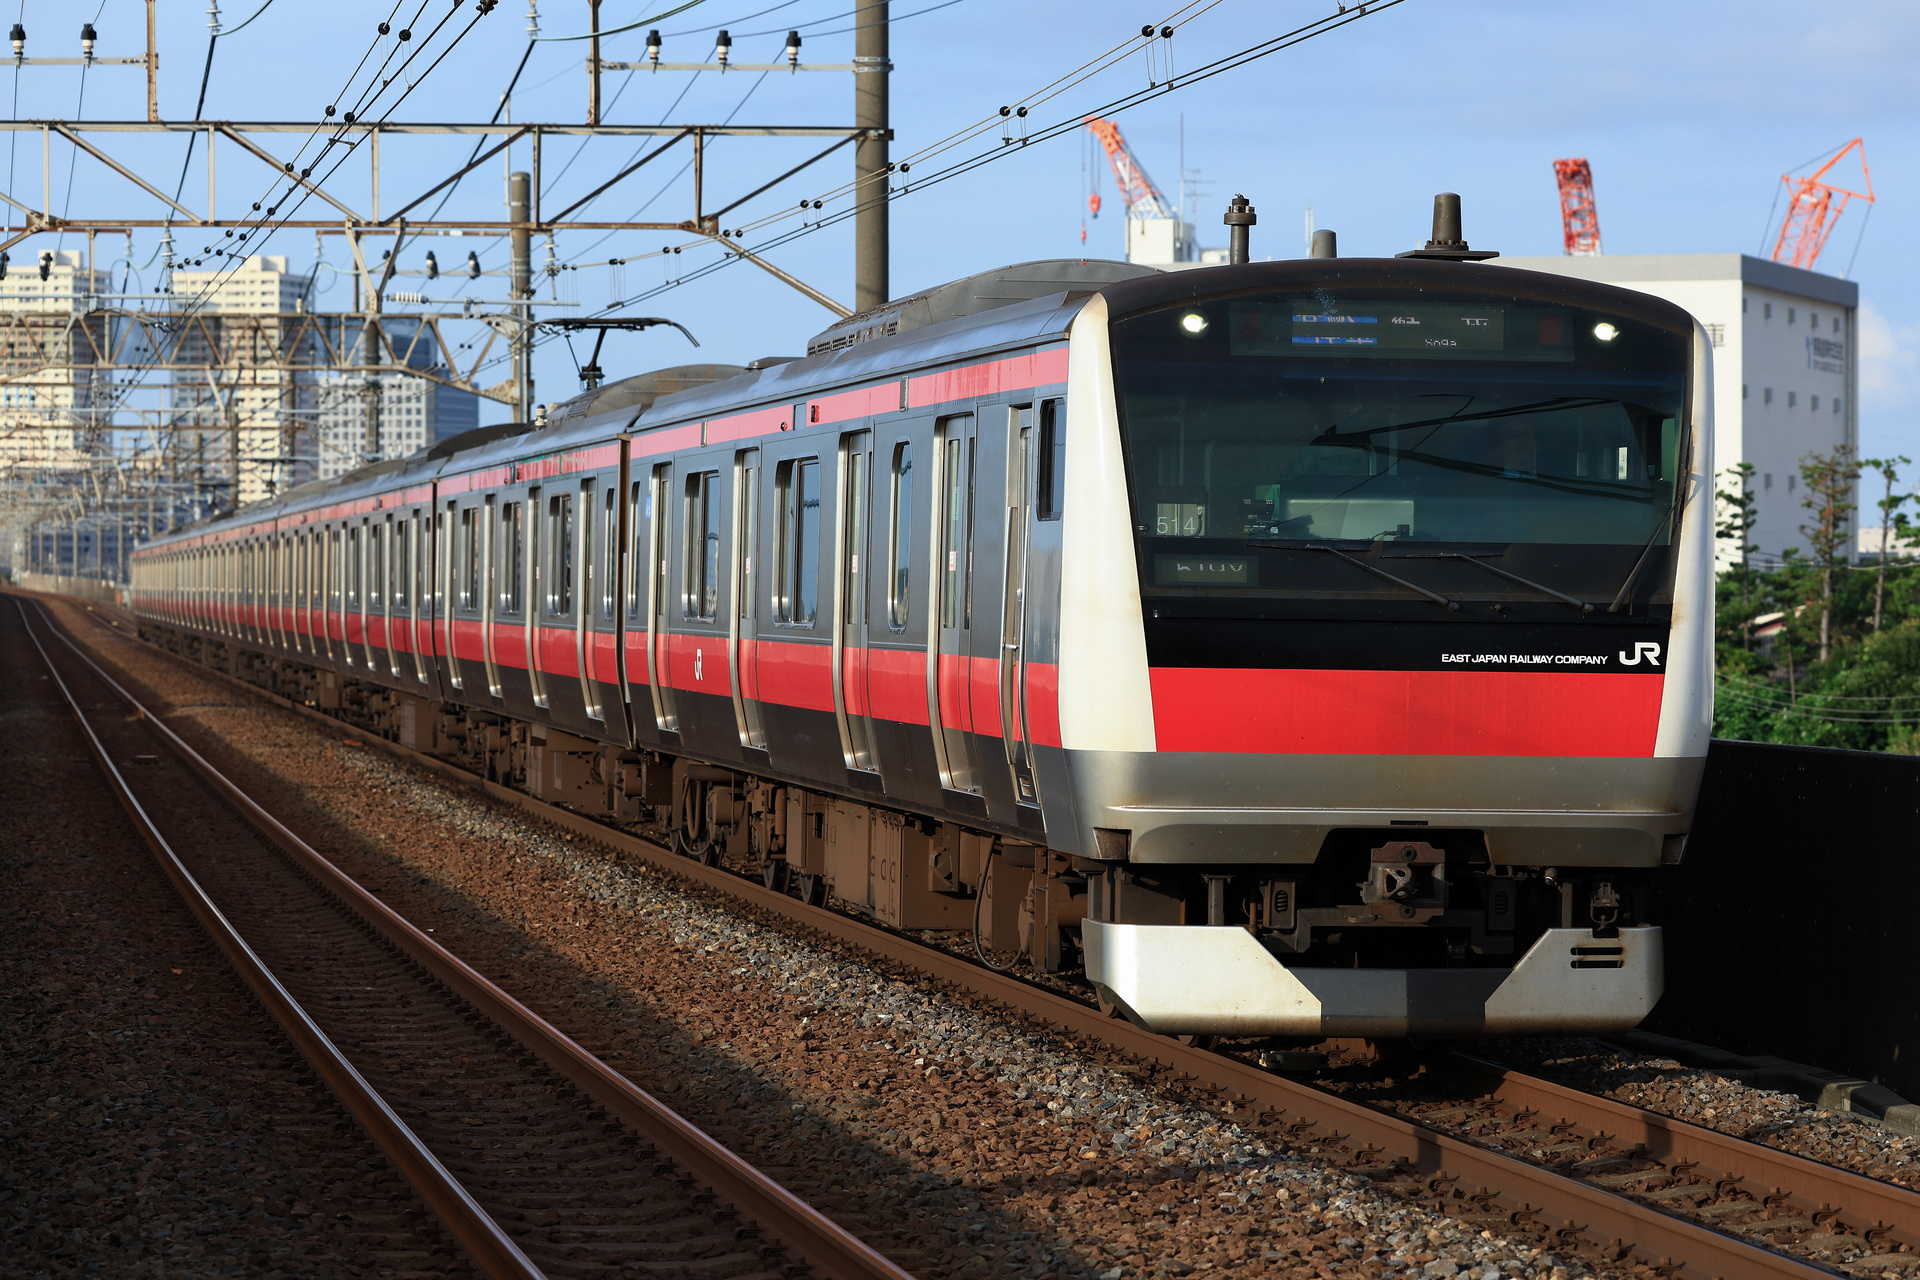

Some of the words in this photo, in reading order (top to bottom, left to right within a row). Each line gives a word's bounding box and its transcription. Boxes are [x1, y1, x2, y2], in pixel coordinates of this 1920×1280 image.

[1157, 516, 1196, 534] 514
[1441, 653, 1471, 663] EAST
[1471, 654, 1508, 664] JAPAN
[1509, 654, 1555, 664] RAILWAY
[1555, 655, 1608, 665] COMPANY
[1619, 641, 1661, 666] JR
[694, 648, 703, 681] JR
